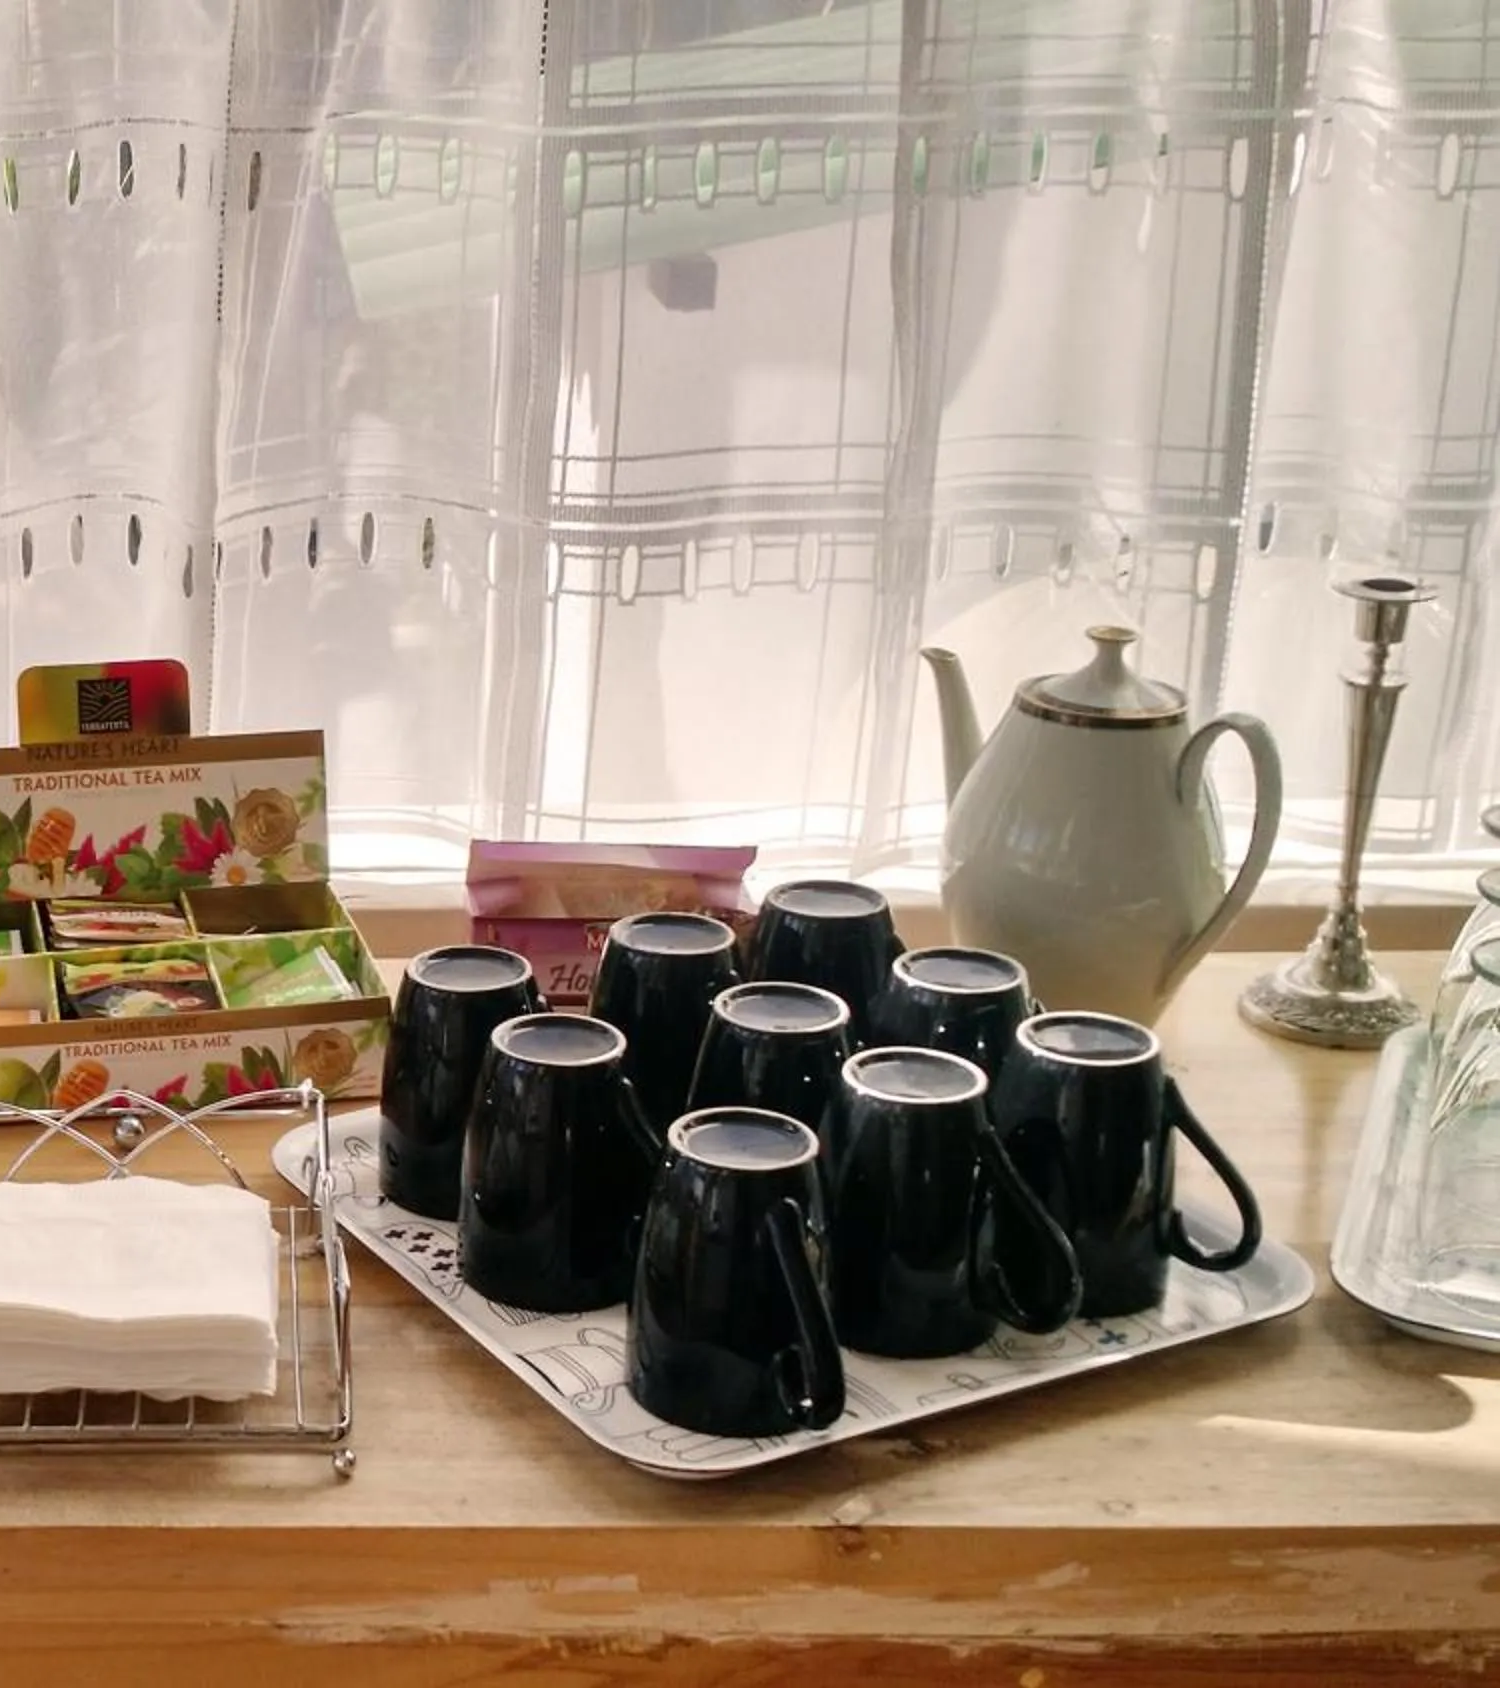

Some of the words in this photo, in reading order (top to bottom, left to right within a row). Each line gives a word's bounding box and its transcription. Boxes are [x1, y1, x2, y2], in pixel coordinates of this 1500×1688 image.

[121, 738, 180, 757] HEART
[13, 772, 128, 793] TRADITIONAL
[132, 769, 165, 785] TEA
[169, 766, 202, 782] MIX
[65, 1040, 165, 1058] TRADITIONAL
[172, 1037, 199, 1050] TEA
[203, 1034, 233, 1048] MIX
